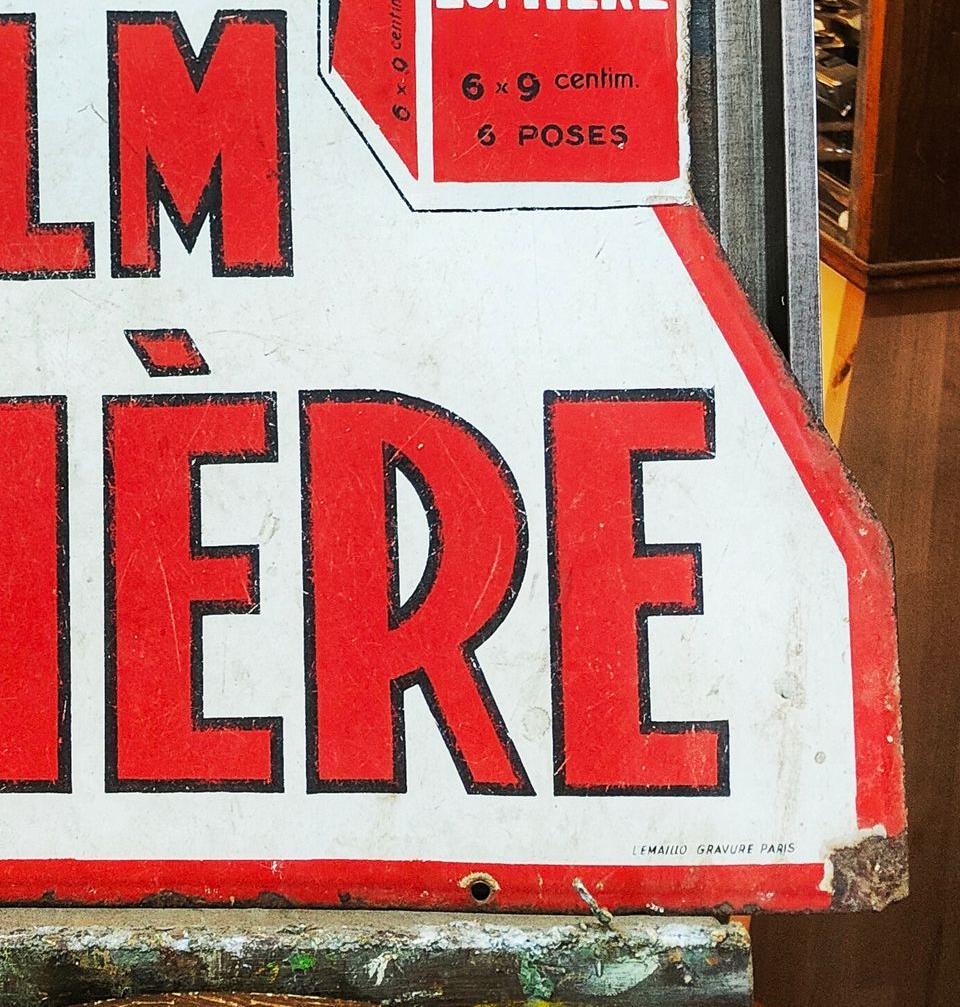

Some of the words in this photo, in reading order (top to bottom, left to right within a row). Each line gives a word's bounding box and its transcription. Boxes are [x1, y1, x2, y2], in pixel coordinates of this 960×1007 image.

[461, 73, 485, 101] 6
[516, 72, 541, 102] 9
[477, 124, 496, 146] 6
[518, 124, 628, 147] POSES
[696, 843, 753, 855] GRAVURE
[760, 843, 795, 854] PARIS
